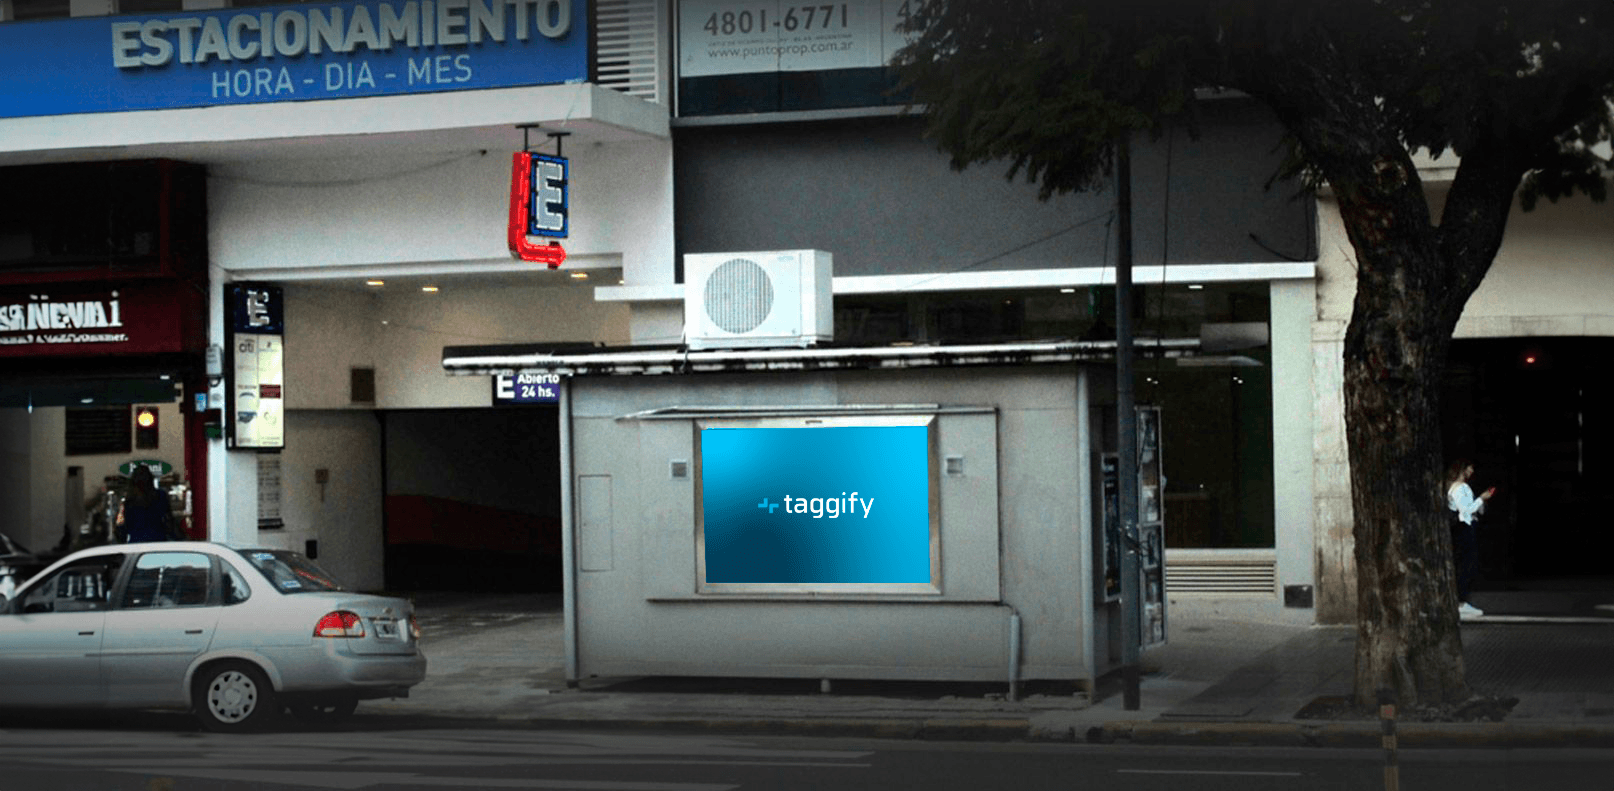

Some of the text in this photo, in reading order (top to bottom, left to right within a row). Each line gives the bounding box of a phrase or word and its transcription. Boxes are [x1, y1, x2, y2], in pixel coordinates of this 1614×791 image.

[111, 0, 571, 67] ESTACIONAMIENTO
[704, 3, 848, 36] 4801-6771
[707, 41, 853, 59] www.puntoprop.com.ar
[211, 67, 294, 97] HORA
[325, 60, 376, 92] DIA
[407, 54, 472, 86] MES
[536, 160, 563, 230] E
[497, 373, 560, 398] E Abierto
[521, 385, 556, 398] 24 hs.
[783, 491, 875, 518] taggify
